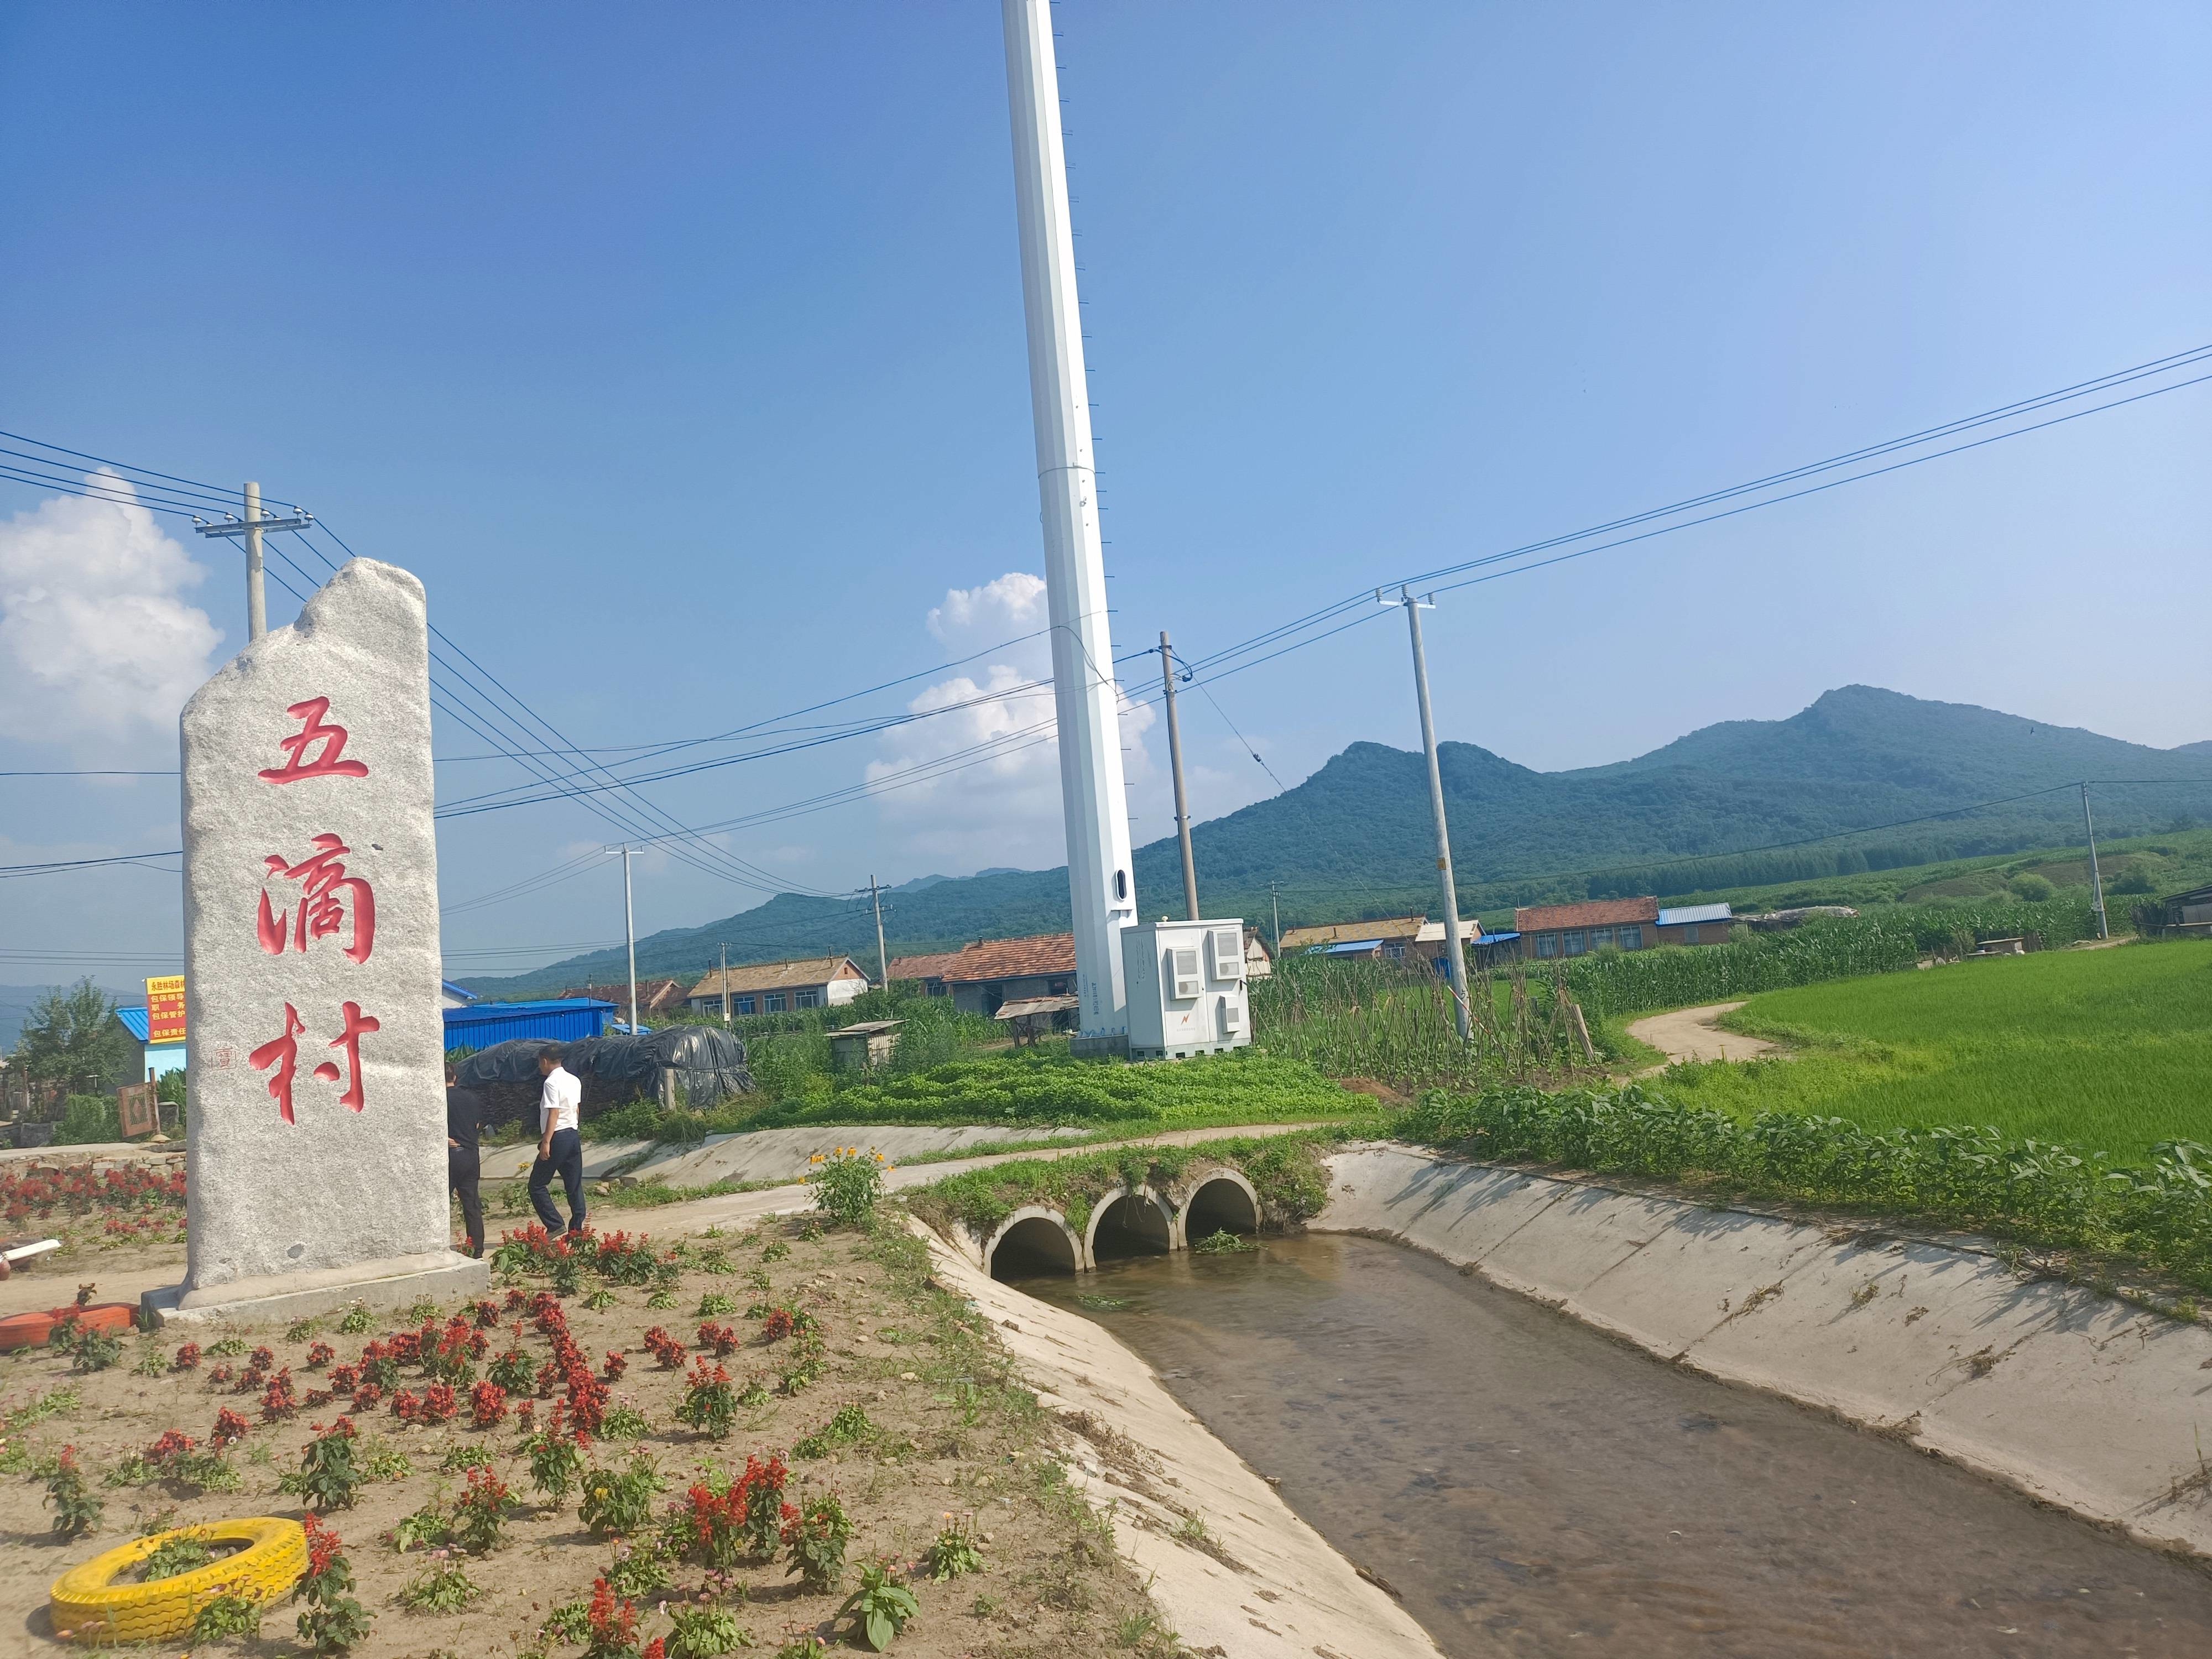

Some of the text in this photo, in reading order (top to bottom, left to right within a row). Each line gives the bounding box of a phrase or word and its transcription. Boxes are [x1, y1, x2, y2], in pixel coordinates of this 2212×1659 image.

[249, 696, 380, 1124] 五滴村
[150, 993, 184, 1003] 包保领导
[152, 1010, 185, 1020] 包保管护
[153, 1027, 186, 1037] 包保责任
